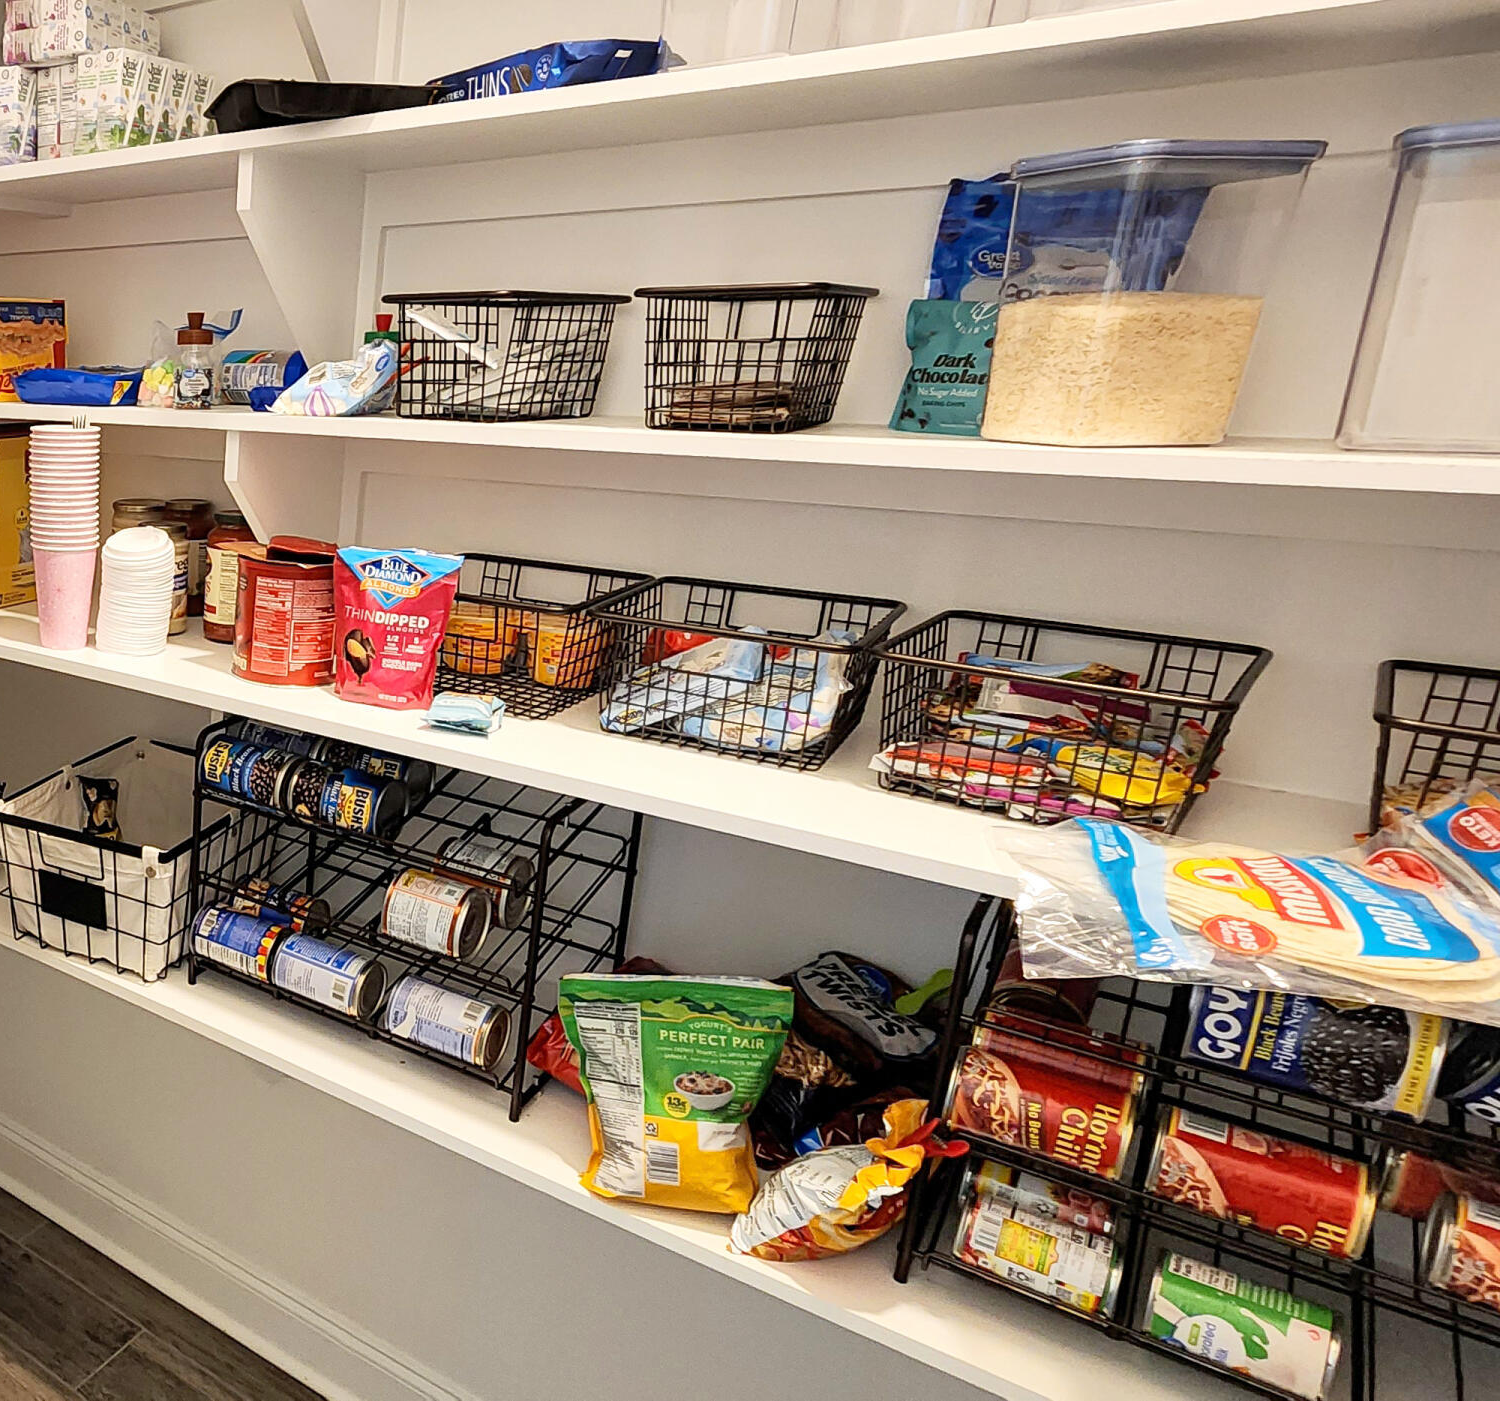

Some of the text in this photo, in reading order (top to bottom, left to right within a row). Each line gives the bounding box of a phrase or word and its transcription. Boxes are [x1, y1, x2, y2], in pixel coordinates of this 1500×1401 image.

[466, 66, 510, 101] THINS
[933, 352, 978, 369] Dark
[911, 368, 989, 385] Chocolat
[949, 388, 978, 398] Added
[365, 565, 422, 583] DIAMOND
[381, 558, 409, 573] BLUE
[365, 578, 417, 596] ALMONDS
[386, 626, 424, 635] ALMONDS
[206, 742, 230, 780] BUSH'S
[235, 745, 256, 767] Beans
[231, 767, 241, 793] Black
[329, 779, 342, 803] Black
[1241, 857, 1332, 925] MISSION
[1365, 905, 1432, 951] CARB
[802, 970, 906, 1037] TWISTS
[688, 1020, 733, 1034] YOGURT'S
[1197, 986, 1251, 1061] GOY
[659, 1029, 766, 1050] PERFECT PAIR
[1253, 1022, 1277, 1061] Black
[1271, 1025, 1298, 1073] Frijoles
[1404, 1072, 1417, 1104] PRIME
[1028, 1102, 1041, 1118] No
[1079, 1103, 1121, 1174] Horme
[1200, 1321, 1217, 1358] orated
